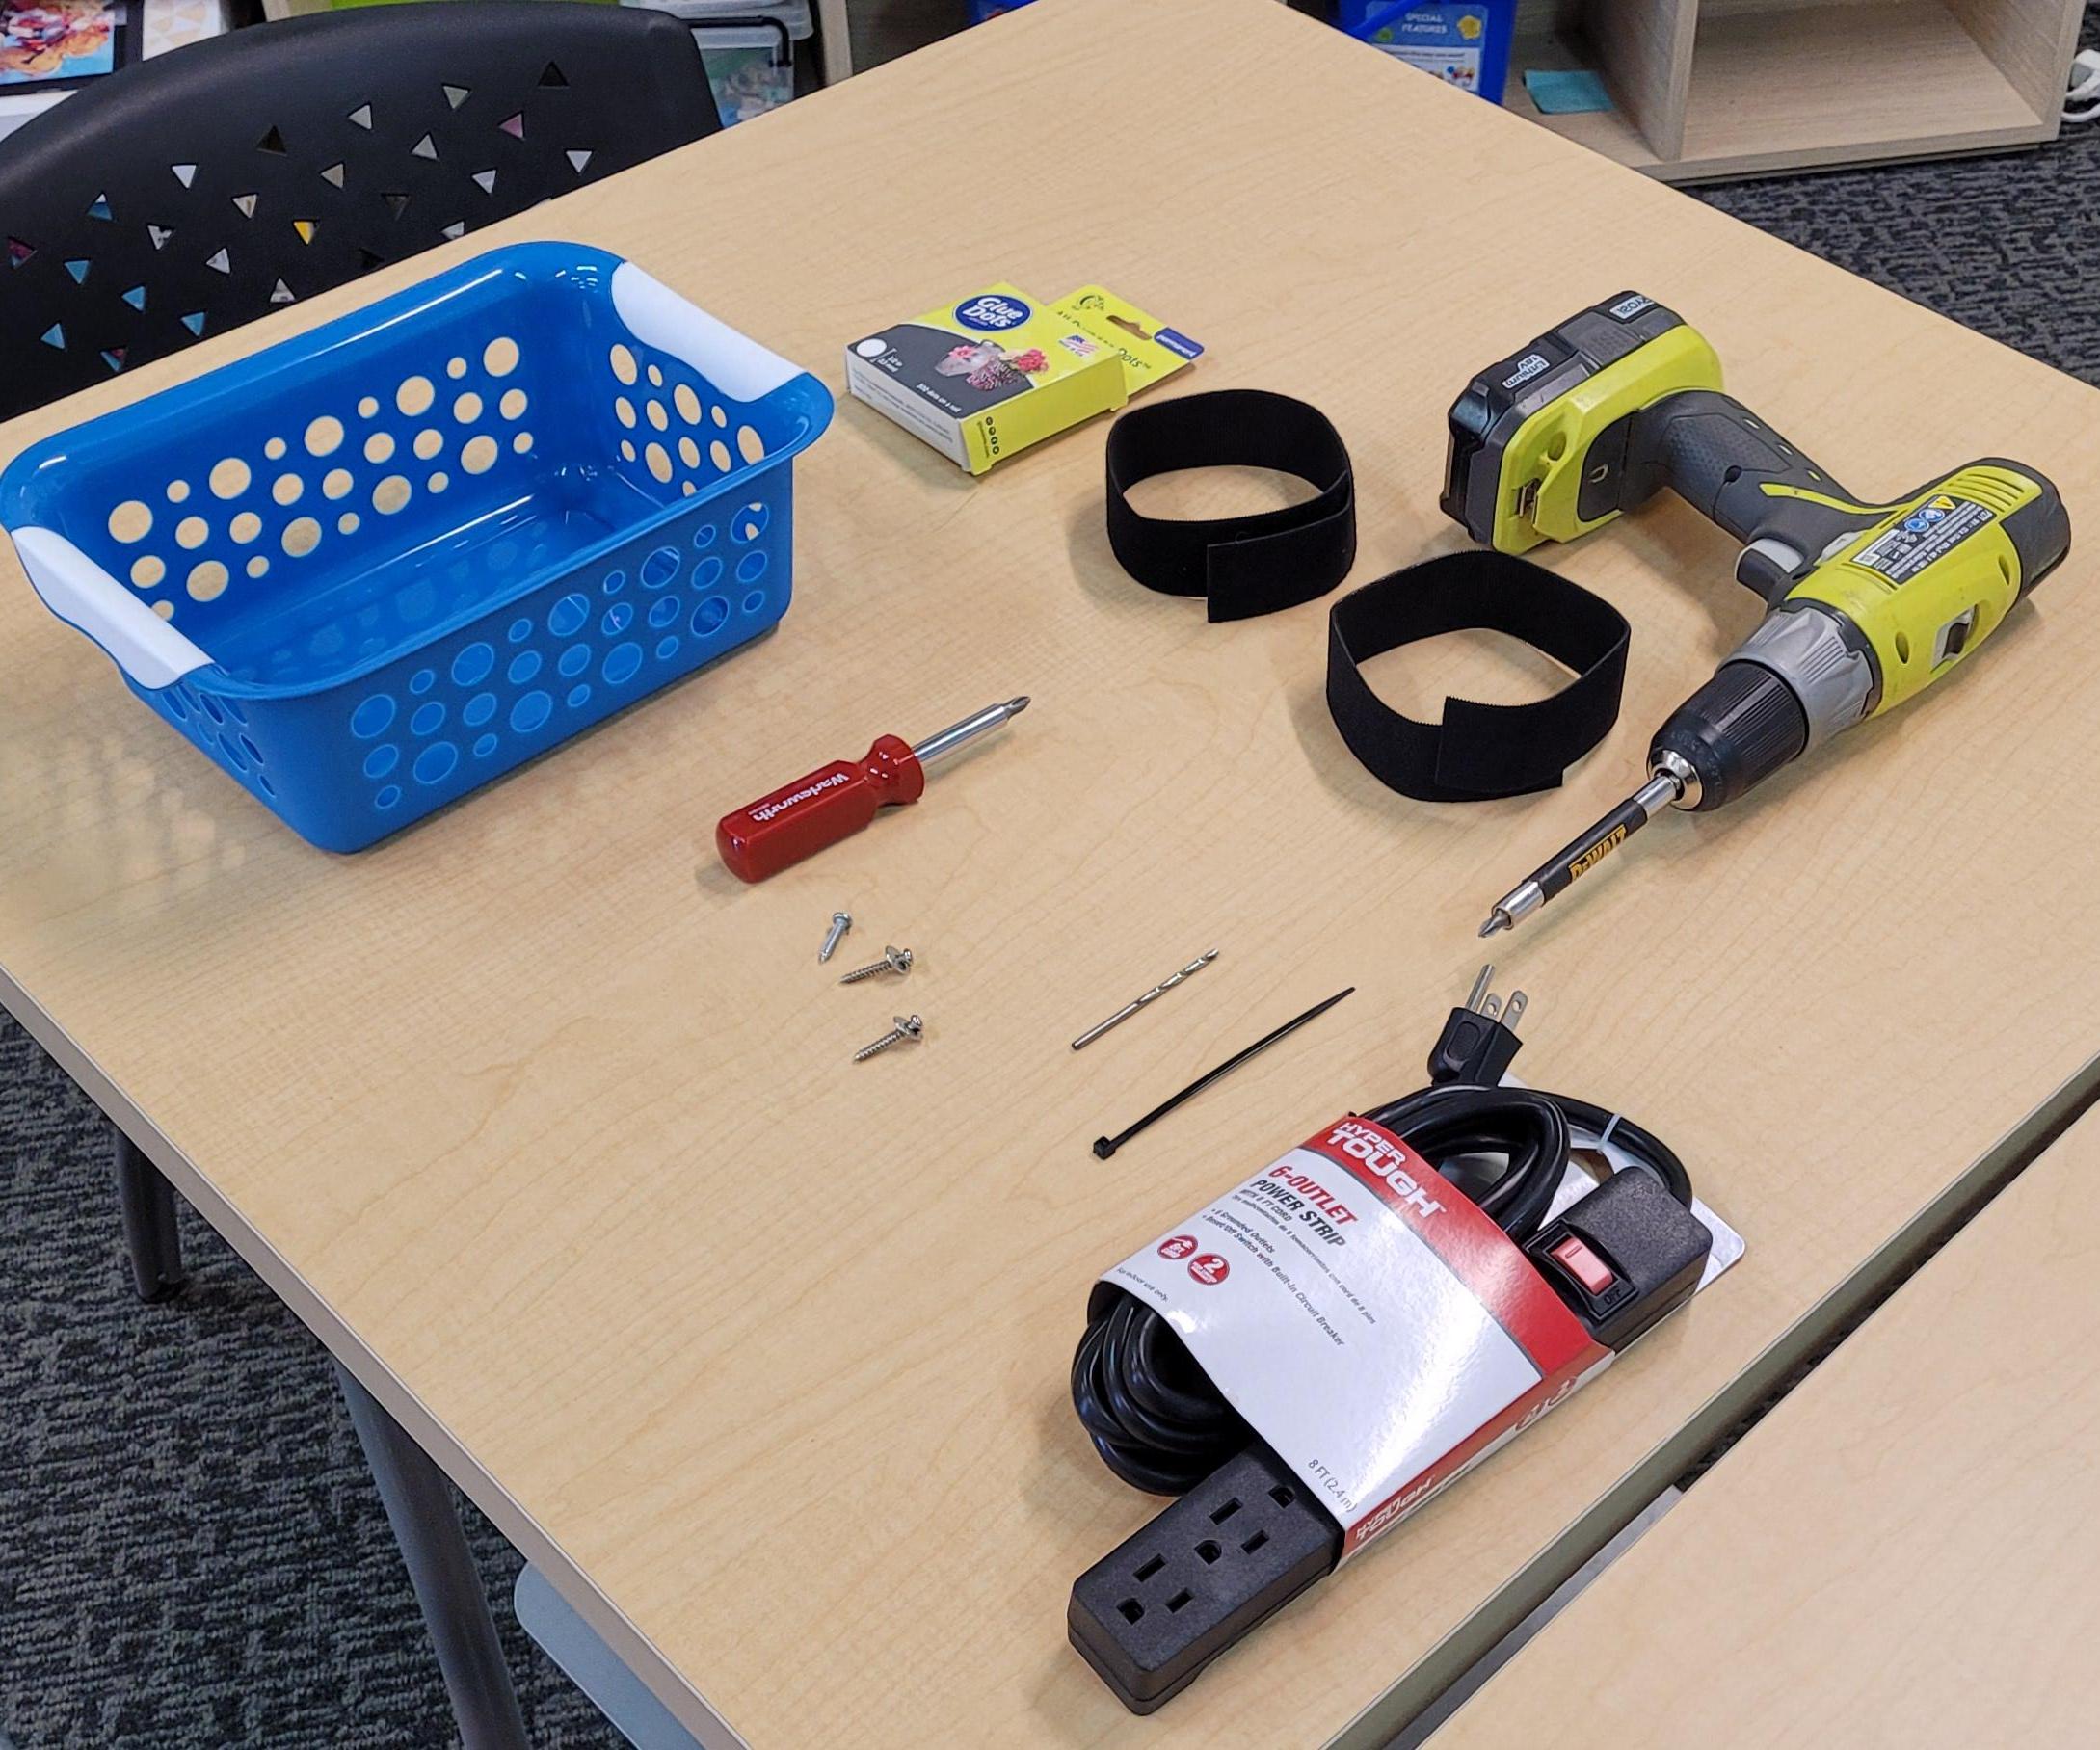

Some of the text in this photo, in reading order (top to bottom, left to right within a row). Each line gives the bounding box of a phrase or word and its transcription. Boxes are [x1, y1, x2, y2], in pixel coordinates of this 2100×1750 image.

[1401, 24, 1449, 34] FEATURES
[1404, 13, 1443, 22] SPECIAL
[962, 305, 1012, 327] Dots
[977, 297, 1023, 319] Glue
[1505, 360, 1548, 386] Lithium
[1338, 1122, 1406, 1166] HYPER
[1327, 1128, 1443, 1218] TOUGH
[1261, 1199, 1275, 1207] FT
[1270, 1206, 1293, 1222] CORD
[1268, 1165, 1358, 1225] 6-OUTLET
[1249, 1179, 1347, 1246] POWER STRIP
[1219, 1211, 1254, 1233] Grounded
[1250, 1232, 1276, 1254] Outlets
[1203, 1258, 1225, 1274] 2
[1234, 1233, 1259, 1254] Switch
[1256, 1252, 1273, 1268] with
[1295, 1291, 1320, 1318] Circuit
[1316, 1316, 1344, 1346] Breaker
[1308, 1459, 1359, 1513] 8 FT (2.4 m)
